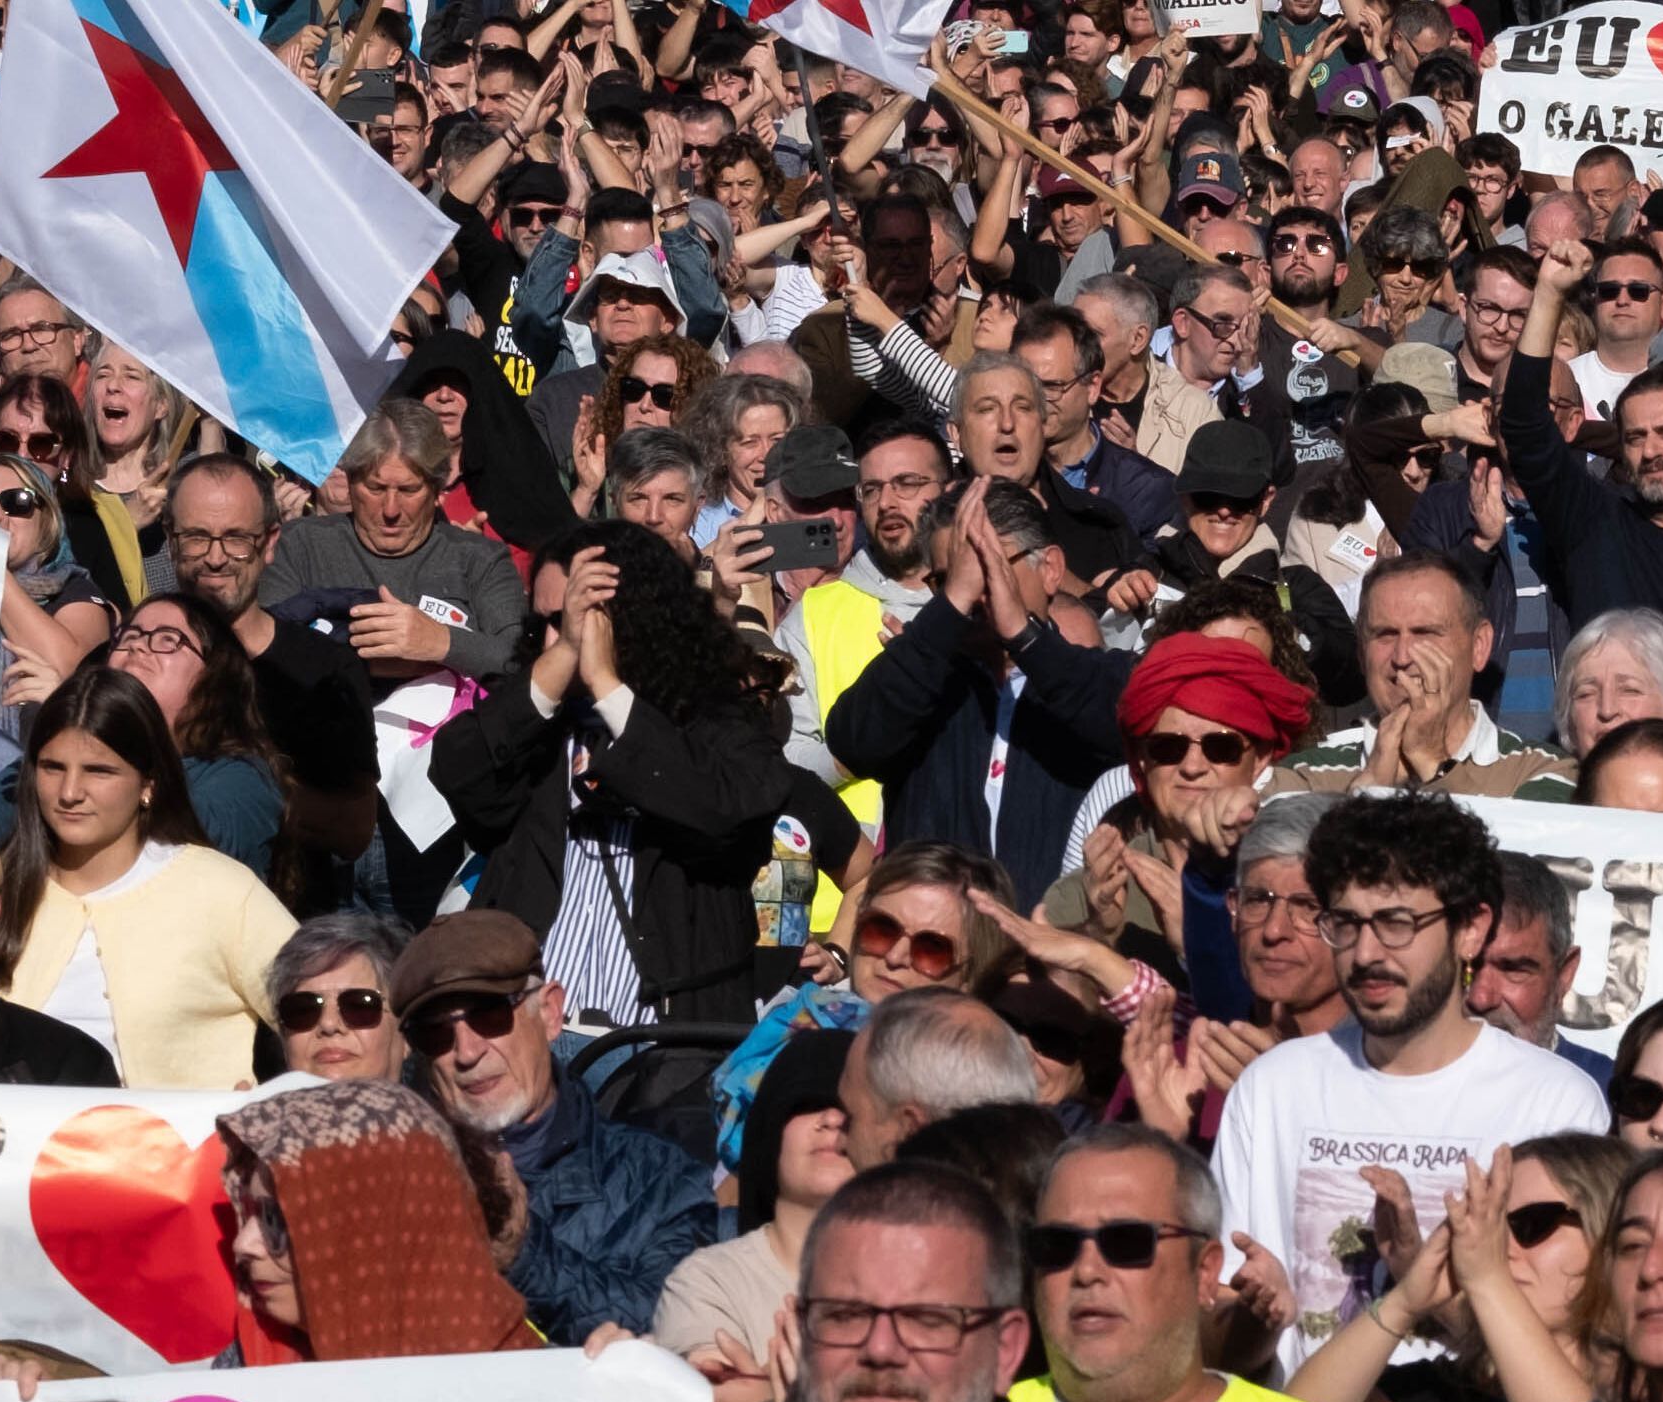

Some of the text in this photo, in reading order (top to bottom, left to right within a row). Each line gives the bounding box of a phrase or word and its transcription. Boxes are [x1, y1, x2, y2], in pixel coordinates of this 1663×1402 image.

[1501, 16, 1641, 79] EU
[1499, 100, 1526, 134] O
[424, 600, 448, 616] EU
[1308, 1137, 1468, 1171] BRASSICA RAPA
